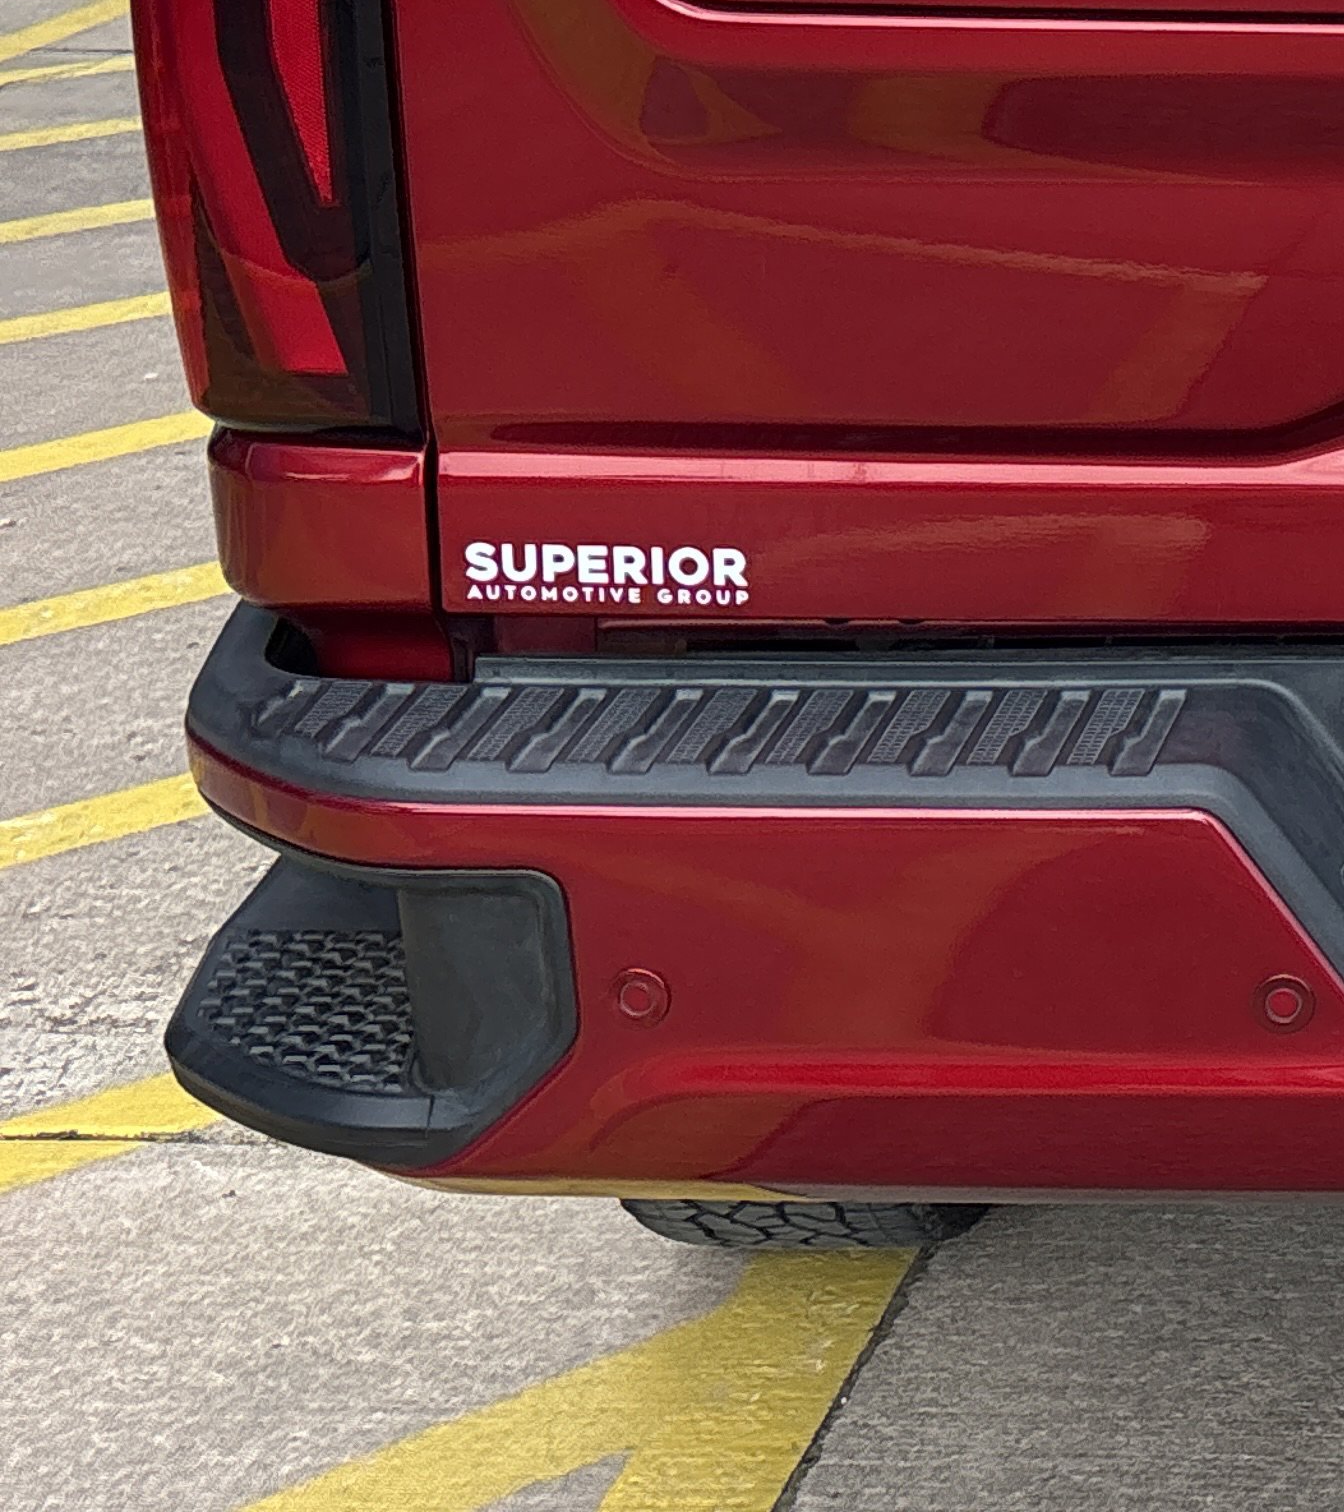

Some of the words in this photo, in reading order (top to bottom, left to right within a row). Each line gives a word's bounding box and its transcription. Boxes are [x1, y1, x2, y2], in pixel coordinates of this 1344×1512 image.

[465, 541, 748, 587] SUPERIOR
[467, 584, 641, 604] AUTOMOTIVE
[657, 588, 749, 606] GROUP
